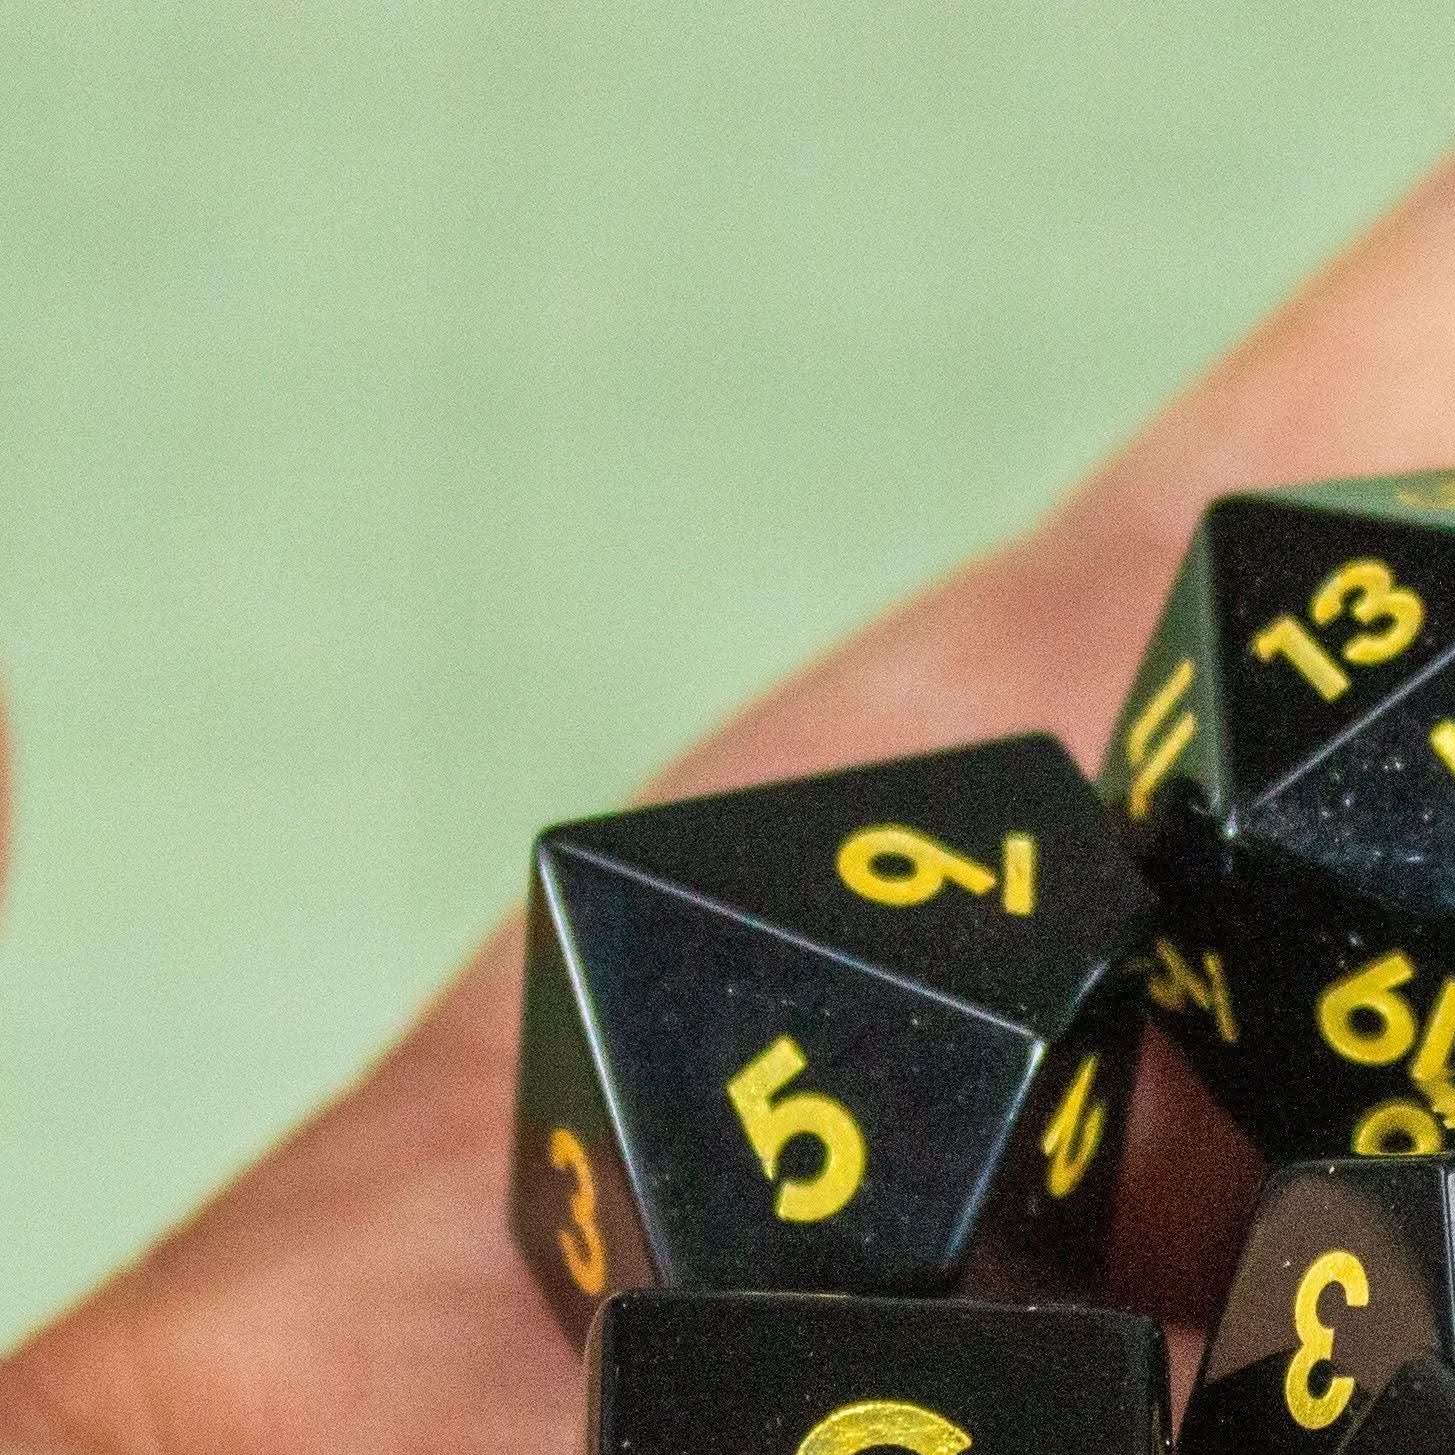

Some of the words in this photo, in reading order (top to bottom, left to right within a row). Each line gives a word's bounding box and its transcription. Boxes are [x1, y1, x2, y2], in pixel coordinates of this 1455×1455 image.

[1251, 557, 1427, 703] 13
[547, 1126, 612, 1297] 3
[724, 1033, 868, 1225] 5
[1283, 1247, 1372, 1431] 3
